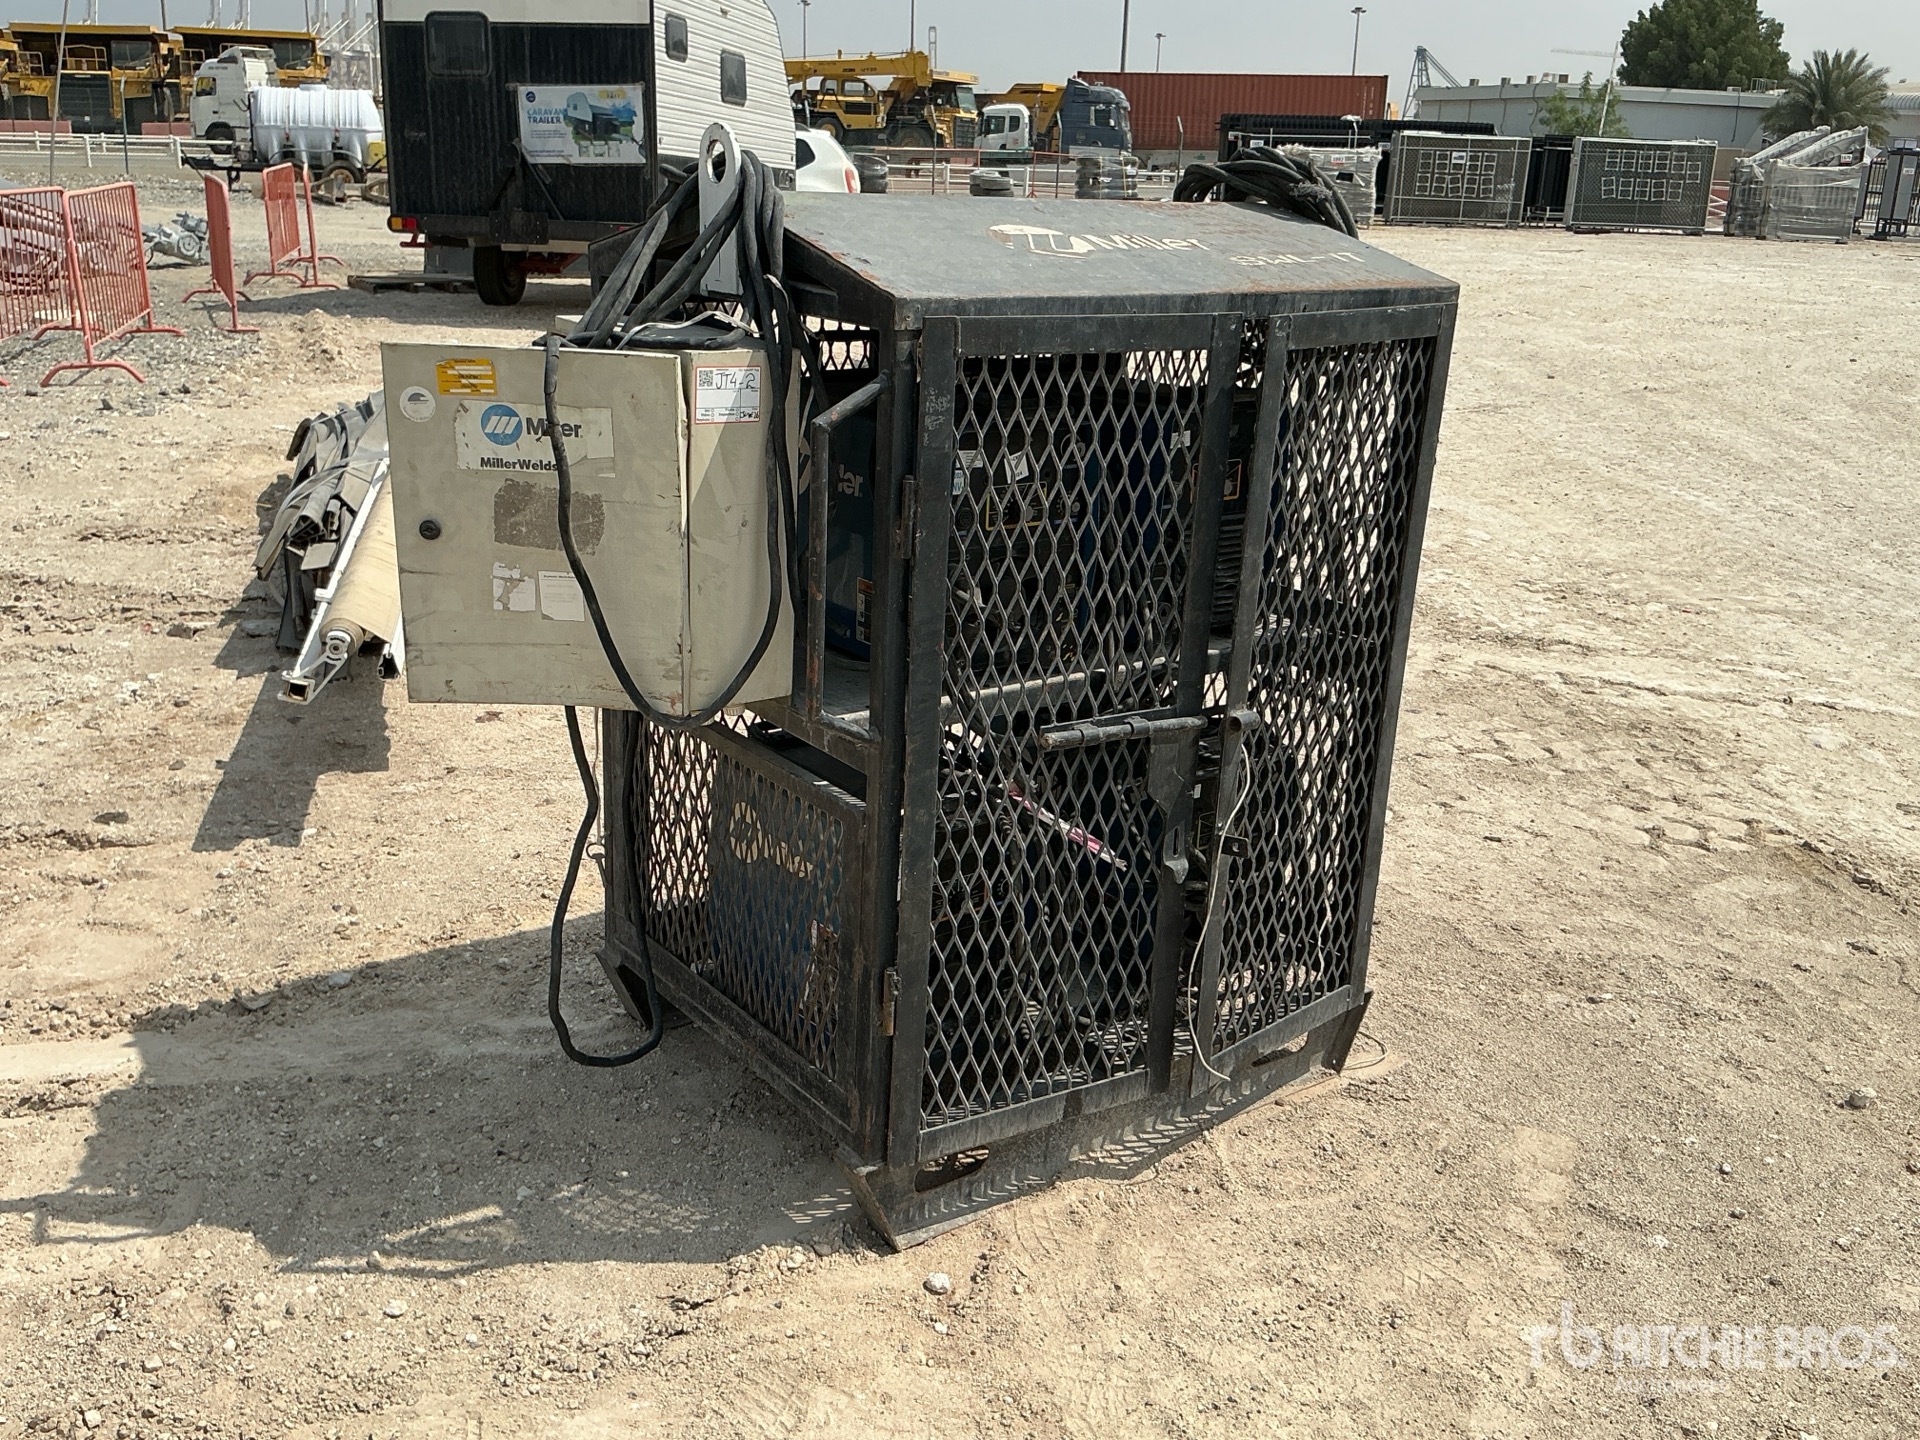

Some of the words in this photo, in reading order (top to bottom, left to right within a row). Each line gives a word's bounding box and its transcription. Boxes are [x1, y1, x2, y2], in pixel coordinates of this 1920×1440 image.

[527, 116, 561, 125] TRAILER
[1081, 234, 1210, 251] Miller
[714, 372, 756, 390] JT4-2
